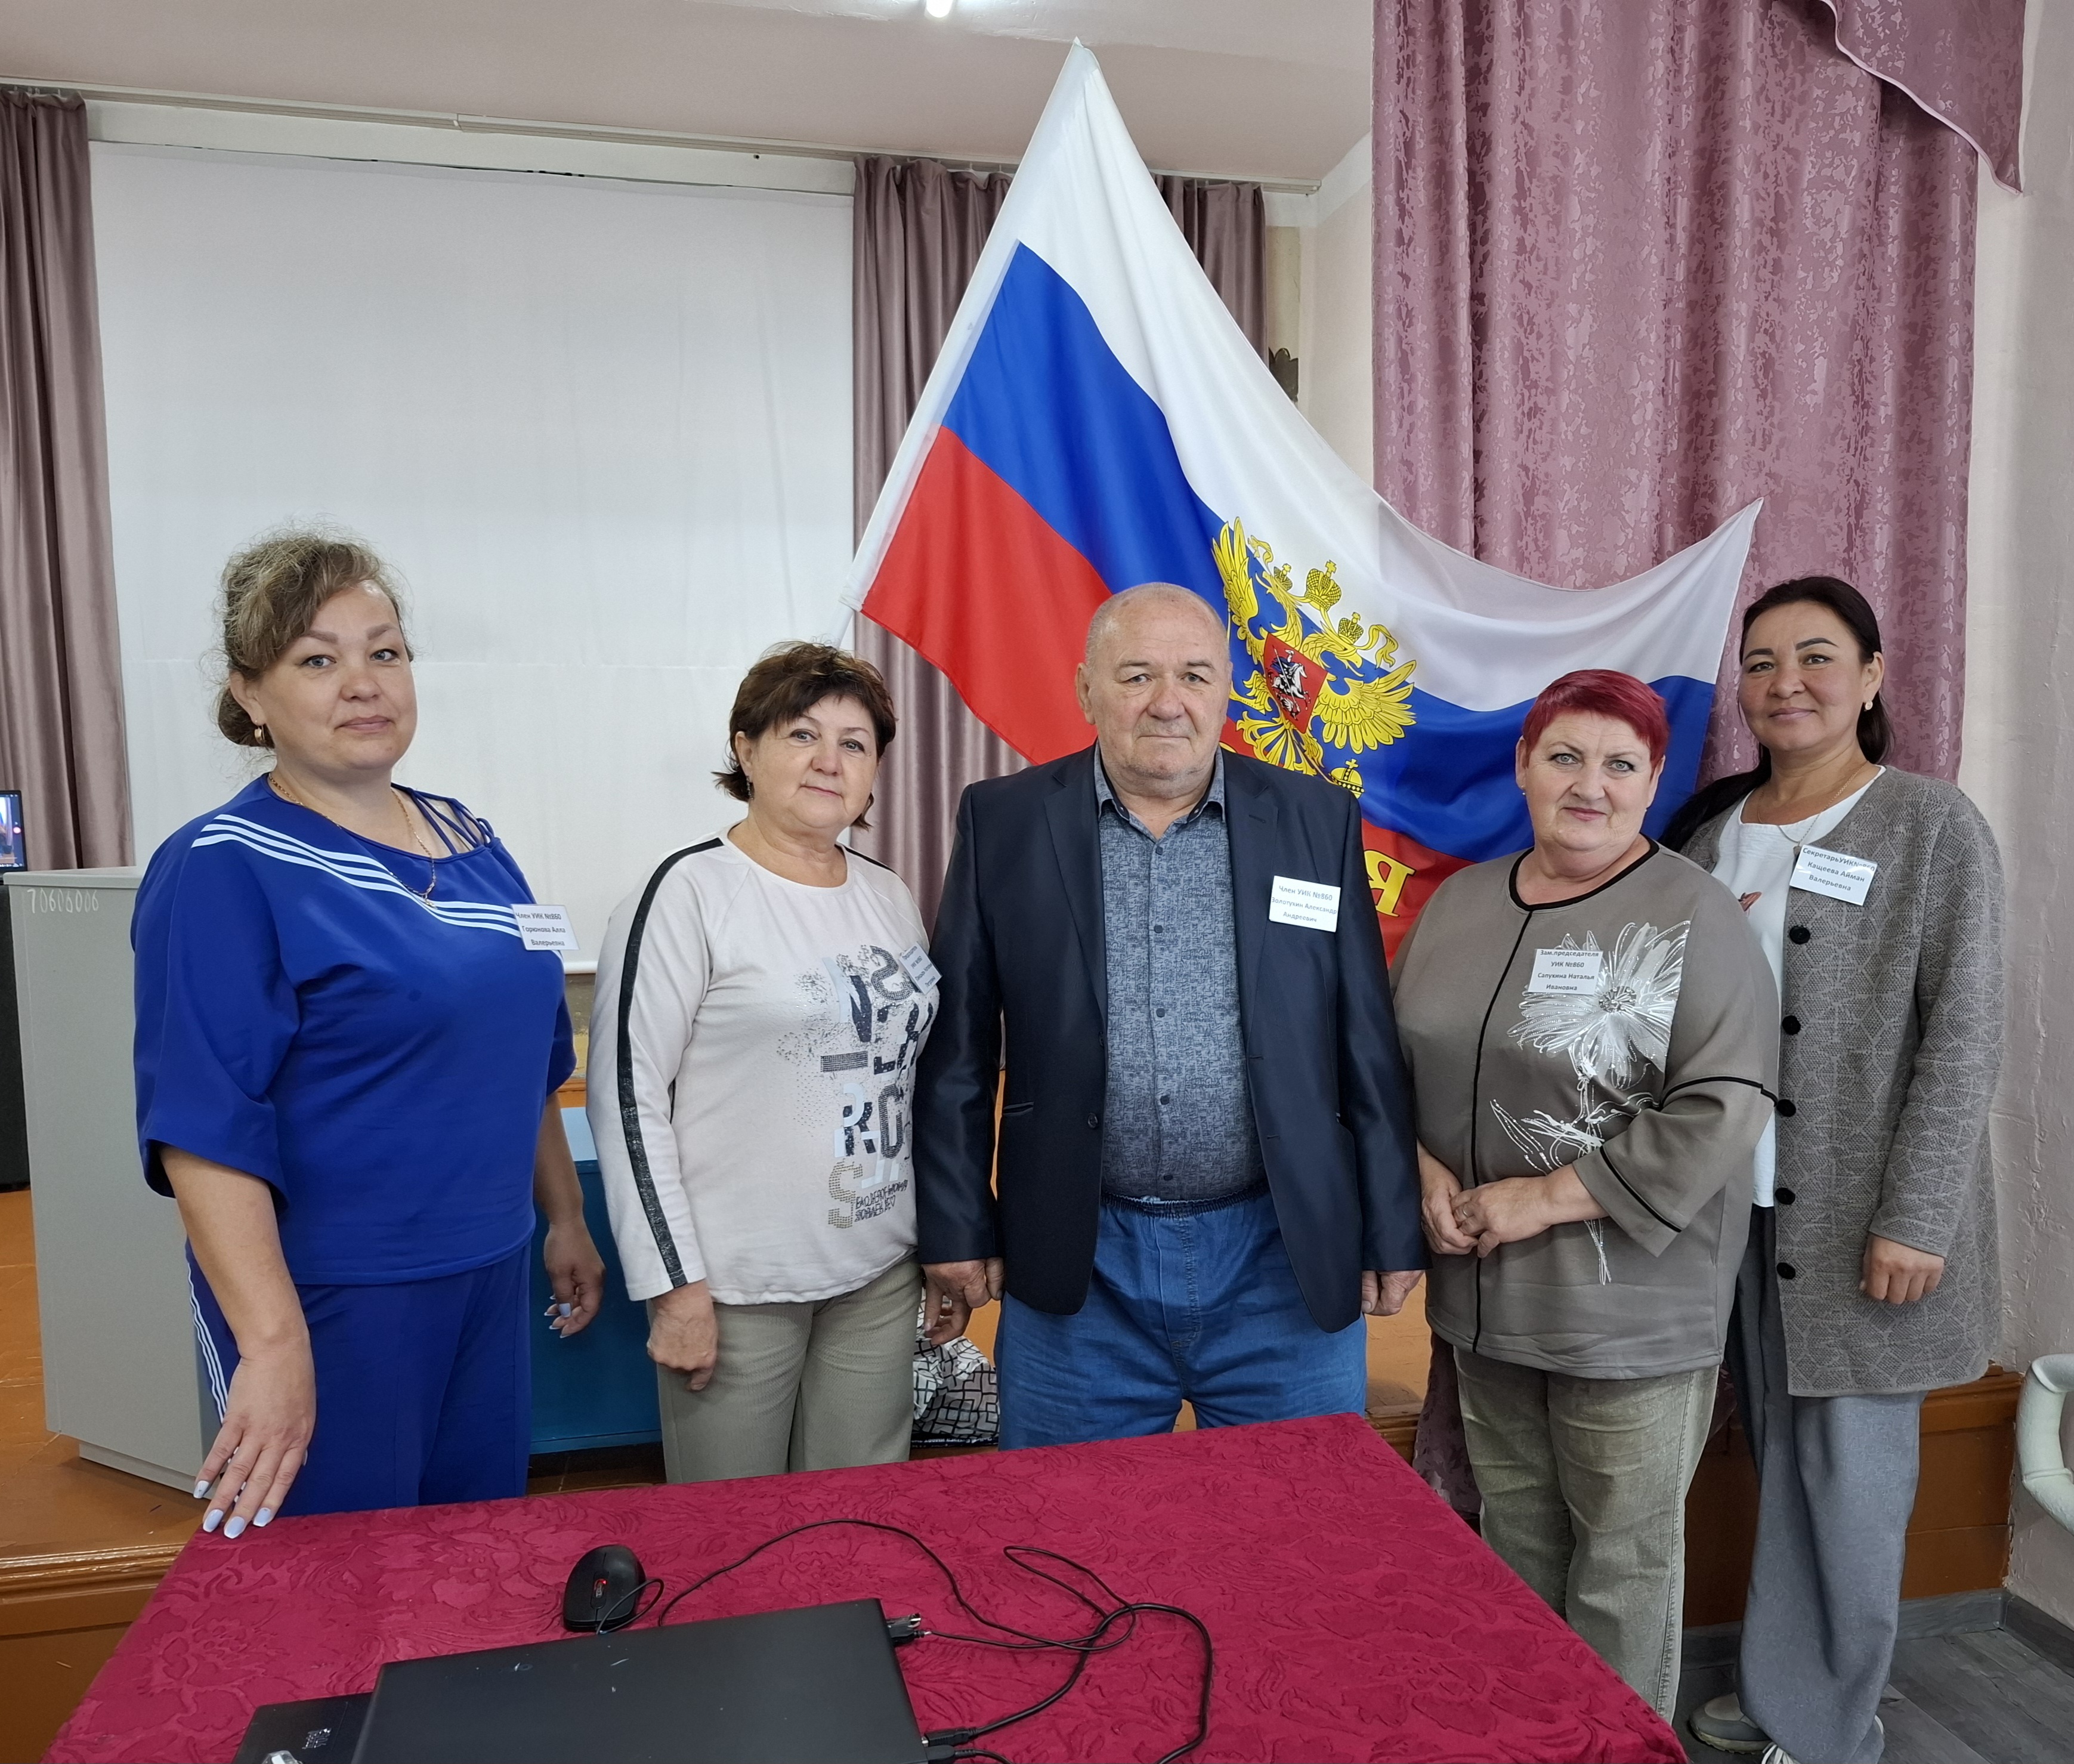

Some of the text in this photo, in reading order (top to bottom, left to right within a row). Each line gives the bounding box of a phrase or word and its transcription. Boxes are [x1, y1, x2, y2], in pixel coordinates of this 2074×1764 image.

[1807, 861, 1865, 882] Кащеева Айман
[1809, 875, 1852, 891] Валерьевна
[1279, 885, 1333, 901] Член УИК №860
[1272, 897, 1337, 915] Золотухин Александр
[1283, 912, 1316, 922] Андреевич
